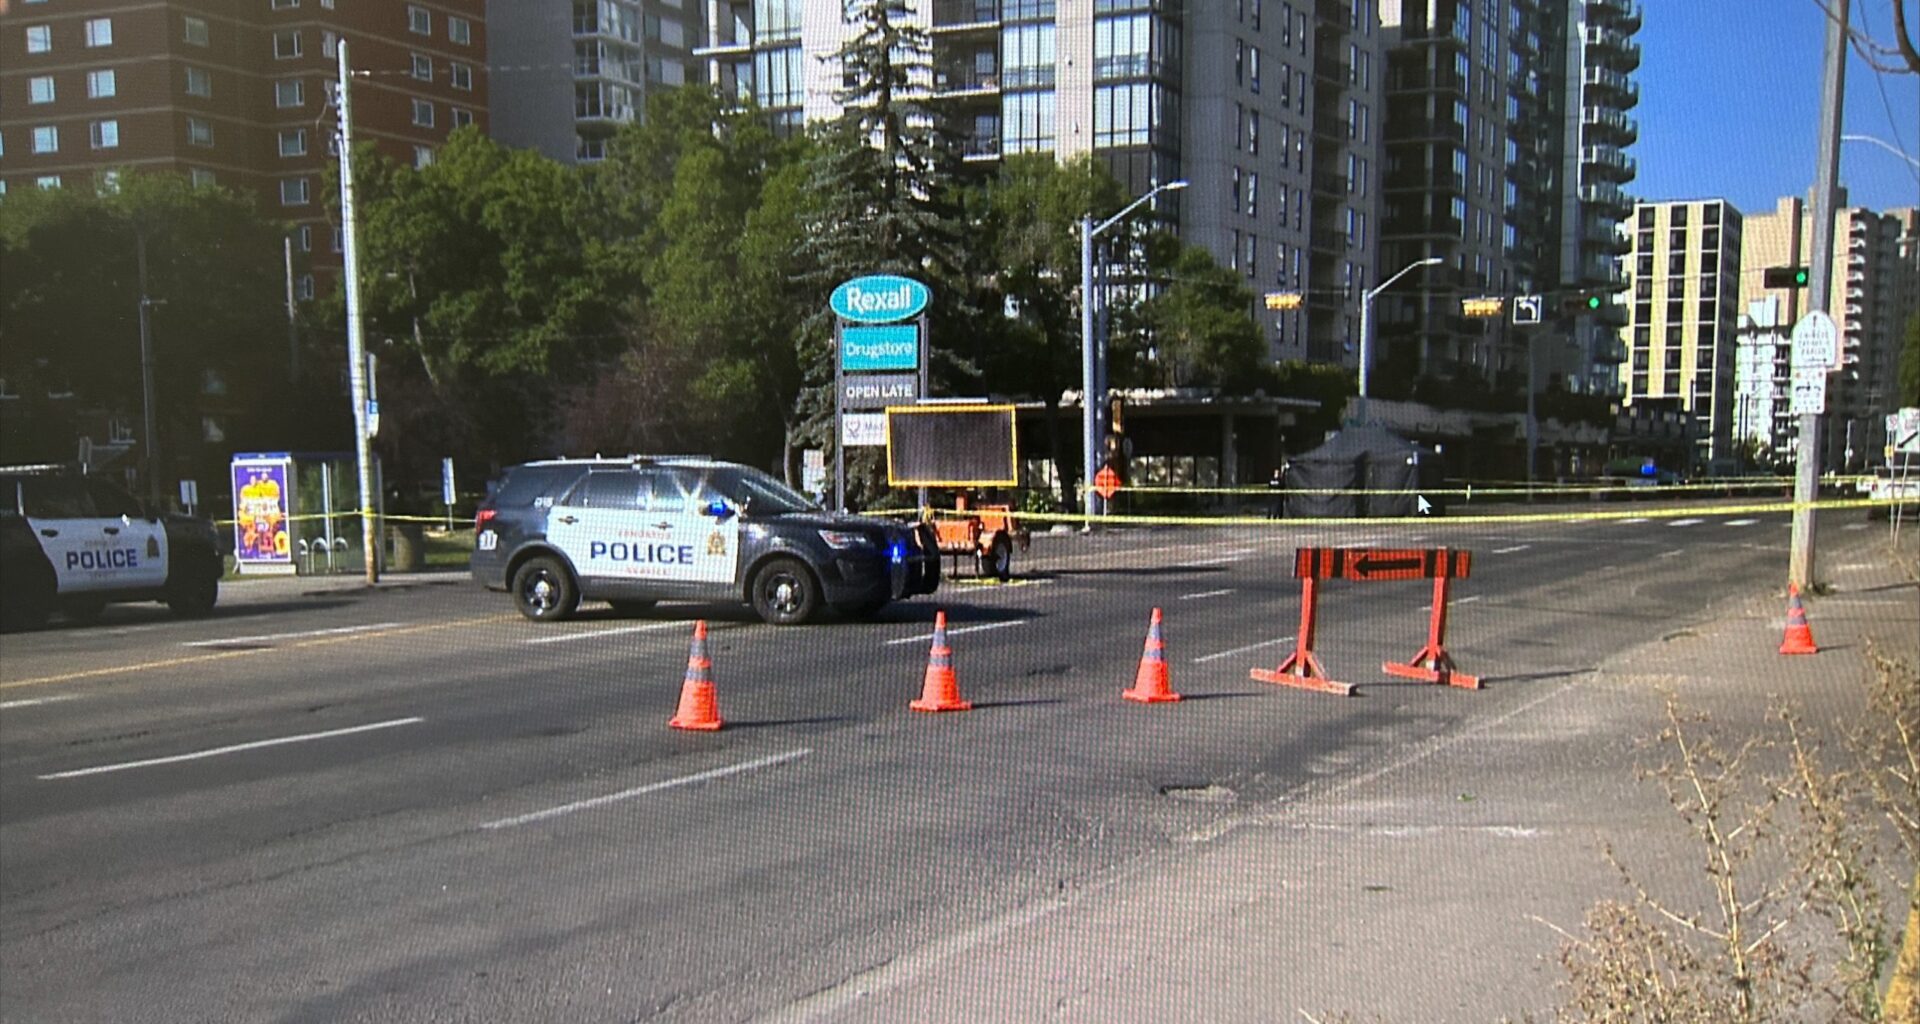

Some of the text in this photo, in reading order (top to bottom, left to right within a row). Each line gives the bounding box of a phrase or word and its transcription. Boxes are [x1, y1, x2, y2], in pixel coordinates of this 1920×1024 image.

[846, 284, 912, 316] Rexall
[846, 341, 914, 360] Drugstore
[845, 384, 913, 399] OPEN LATE
[66, 549, 138, 570] POLICE
[590, 540, 694, 565] POLICE
